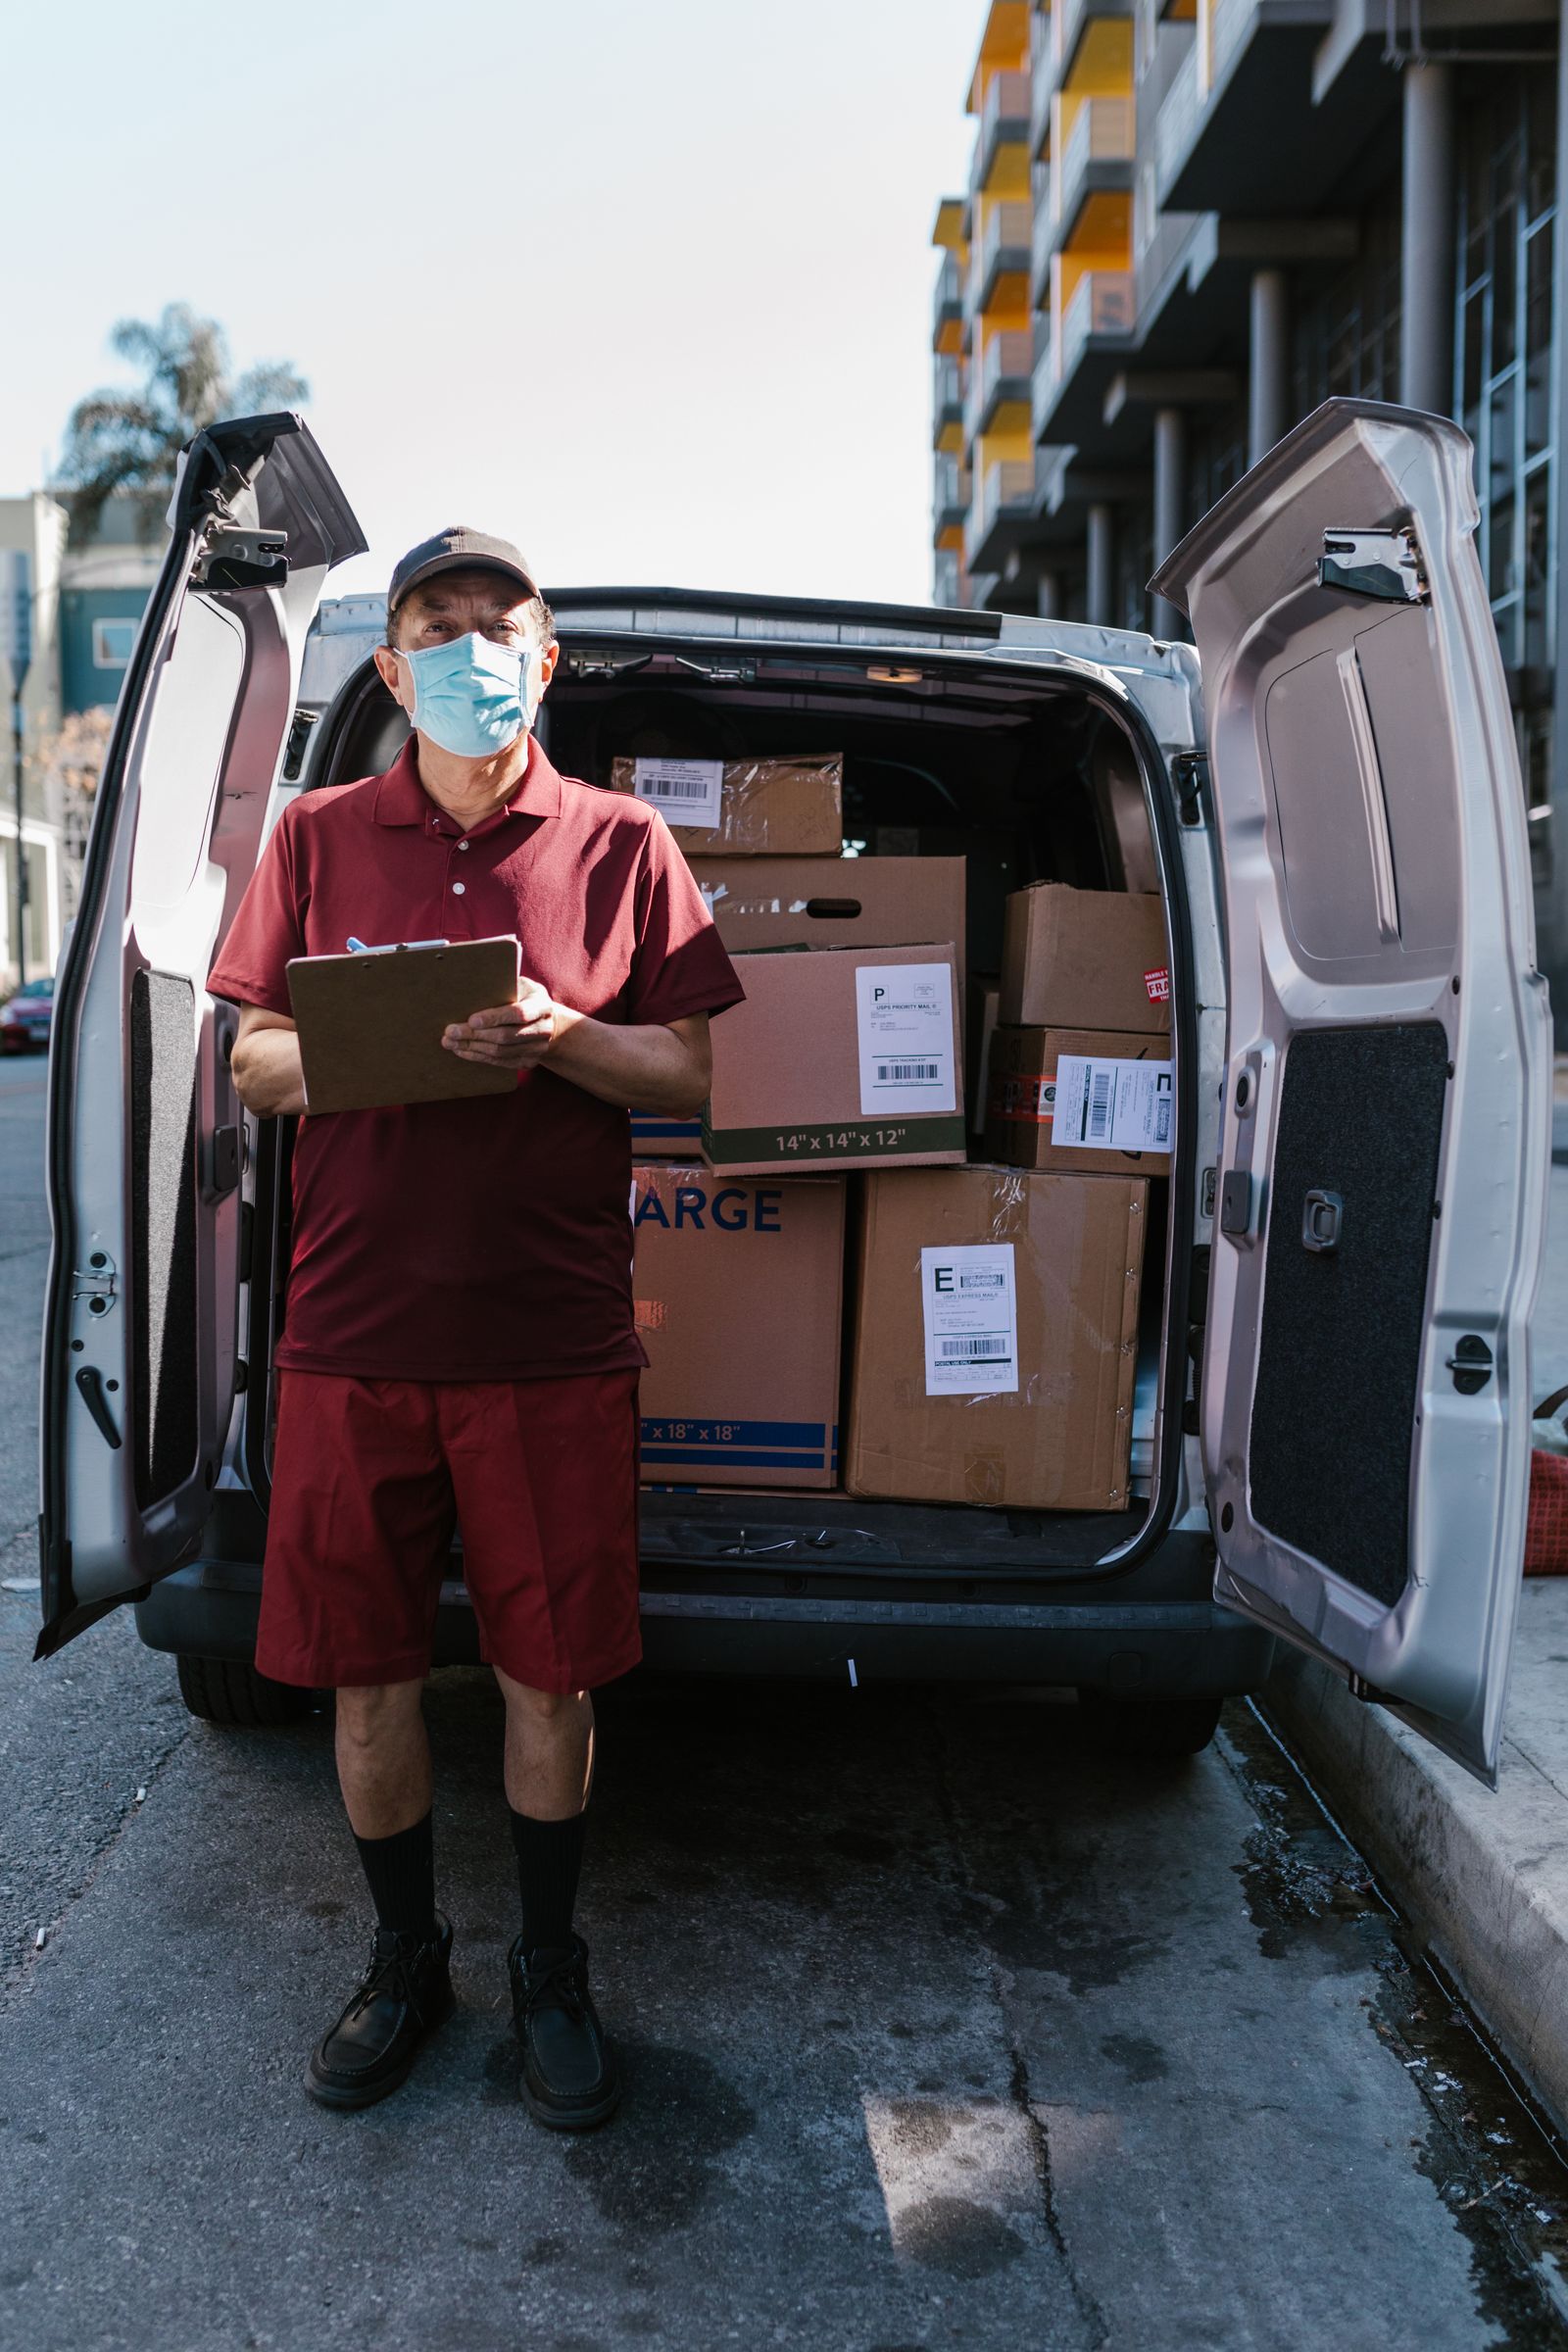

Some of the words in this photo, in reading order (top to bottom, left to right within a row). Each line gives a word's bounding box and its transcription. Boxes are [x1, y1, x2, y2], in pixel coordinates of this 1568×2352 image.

[1145, 970, 1164, 981] HANDLE
[874, 988, 885, 1002] P
[775, 1134, 807, 1152] 14"
[809, 1137, 821, 1150] x
[826, 1132, 857, 1149] 14"
[859, 1134, 870, 1147] x
[875, 1128, 906, 1146] 12"
[634, 1185, 783, 1232] ARGE
[935, 1267, 955, 1293] E
[652, 1427, 662, 1439] x
[667, 1423, 695, 1440] 18"
[699, 1429, 709, 1440] x
[713, 1425, 741, 1441] 18"
